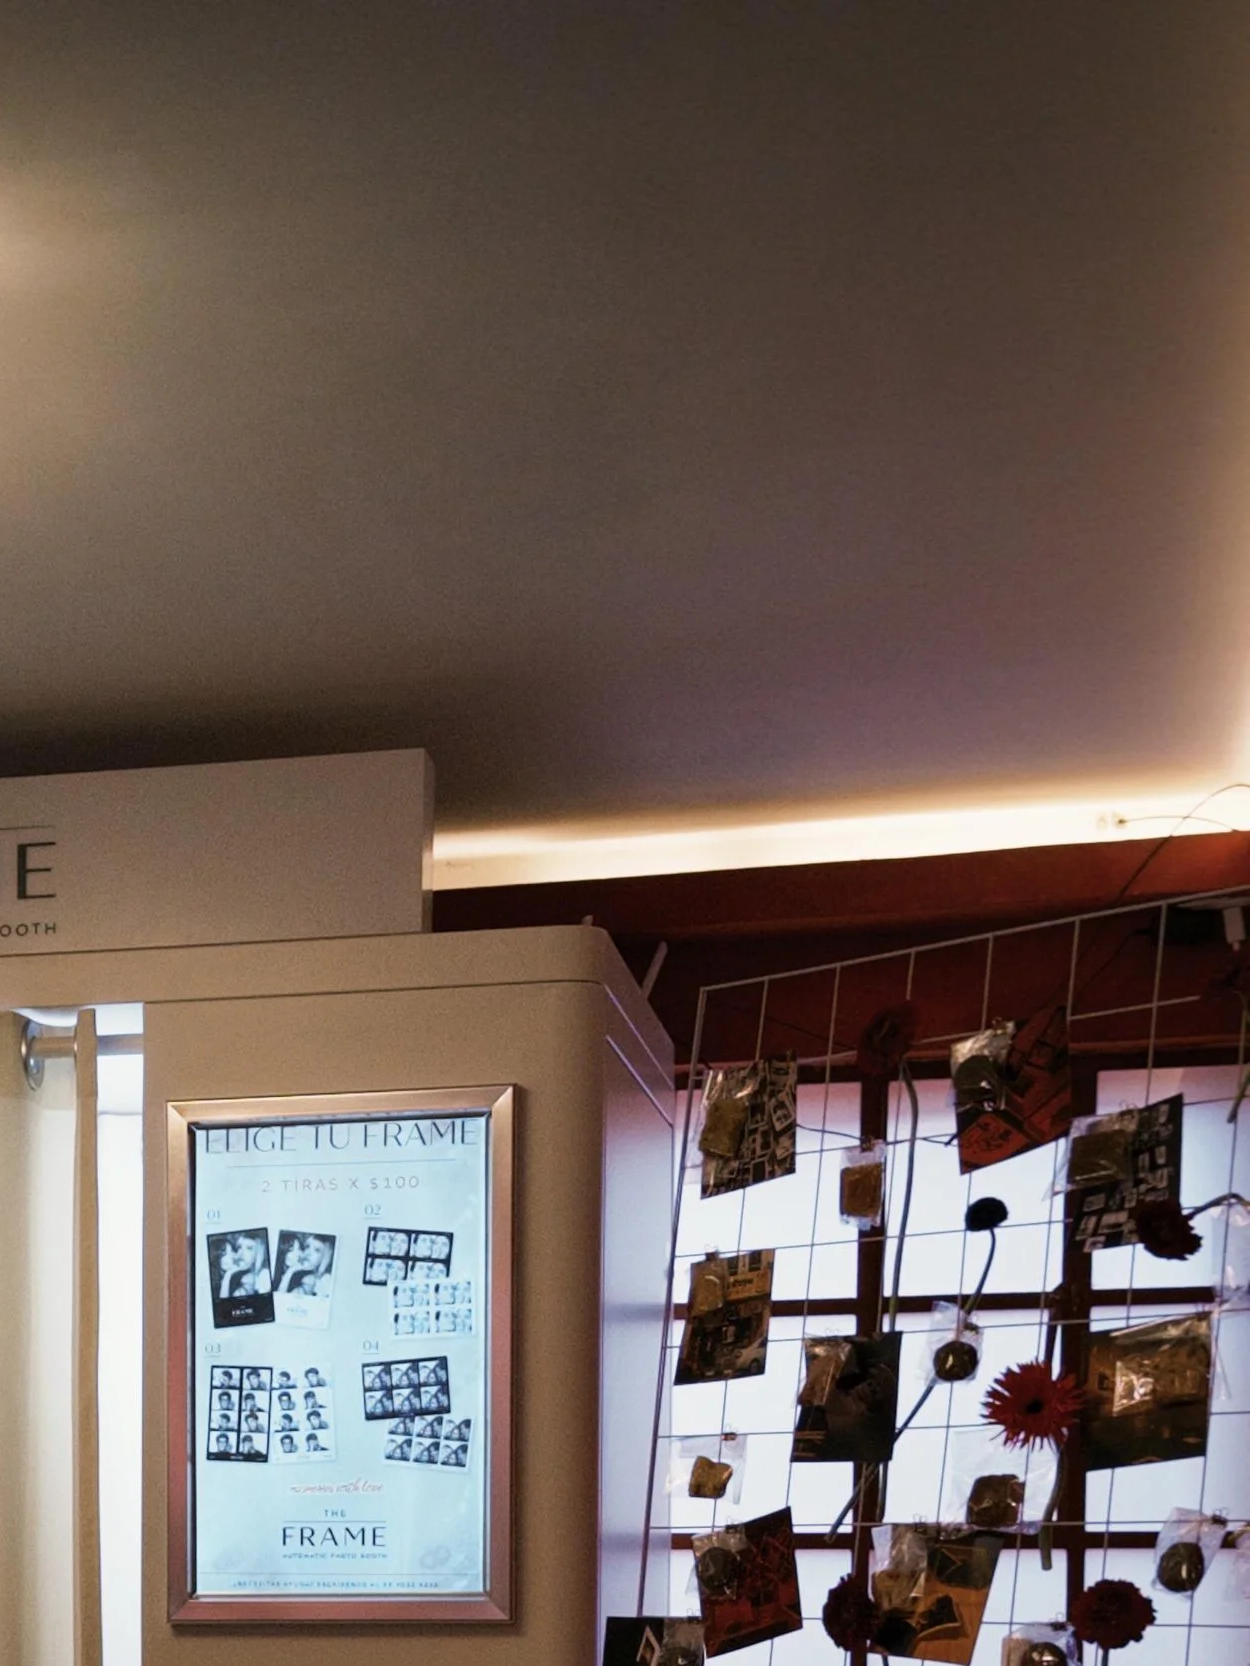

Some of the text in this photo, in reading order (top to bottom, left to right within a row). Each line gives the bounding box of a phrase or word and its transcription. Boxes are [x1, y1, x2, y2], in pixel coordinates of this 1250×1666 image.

[206, 1118, 478, 1153] ELIGE TU FRAME
[261, 1180, 271, 1193] 2
[282, 1177, 339, 1192] TIRAS
[369, 1175, 420, 1191] $100
[364, 1204, 381, 1216] 02
[324, 1509, 346, 1518] THE
[282, 1526, 387, 1547] FRAME
